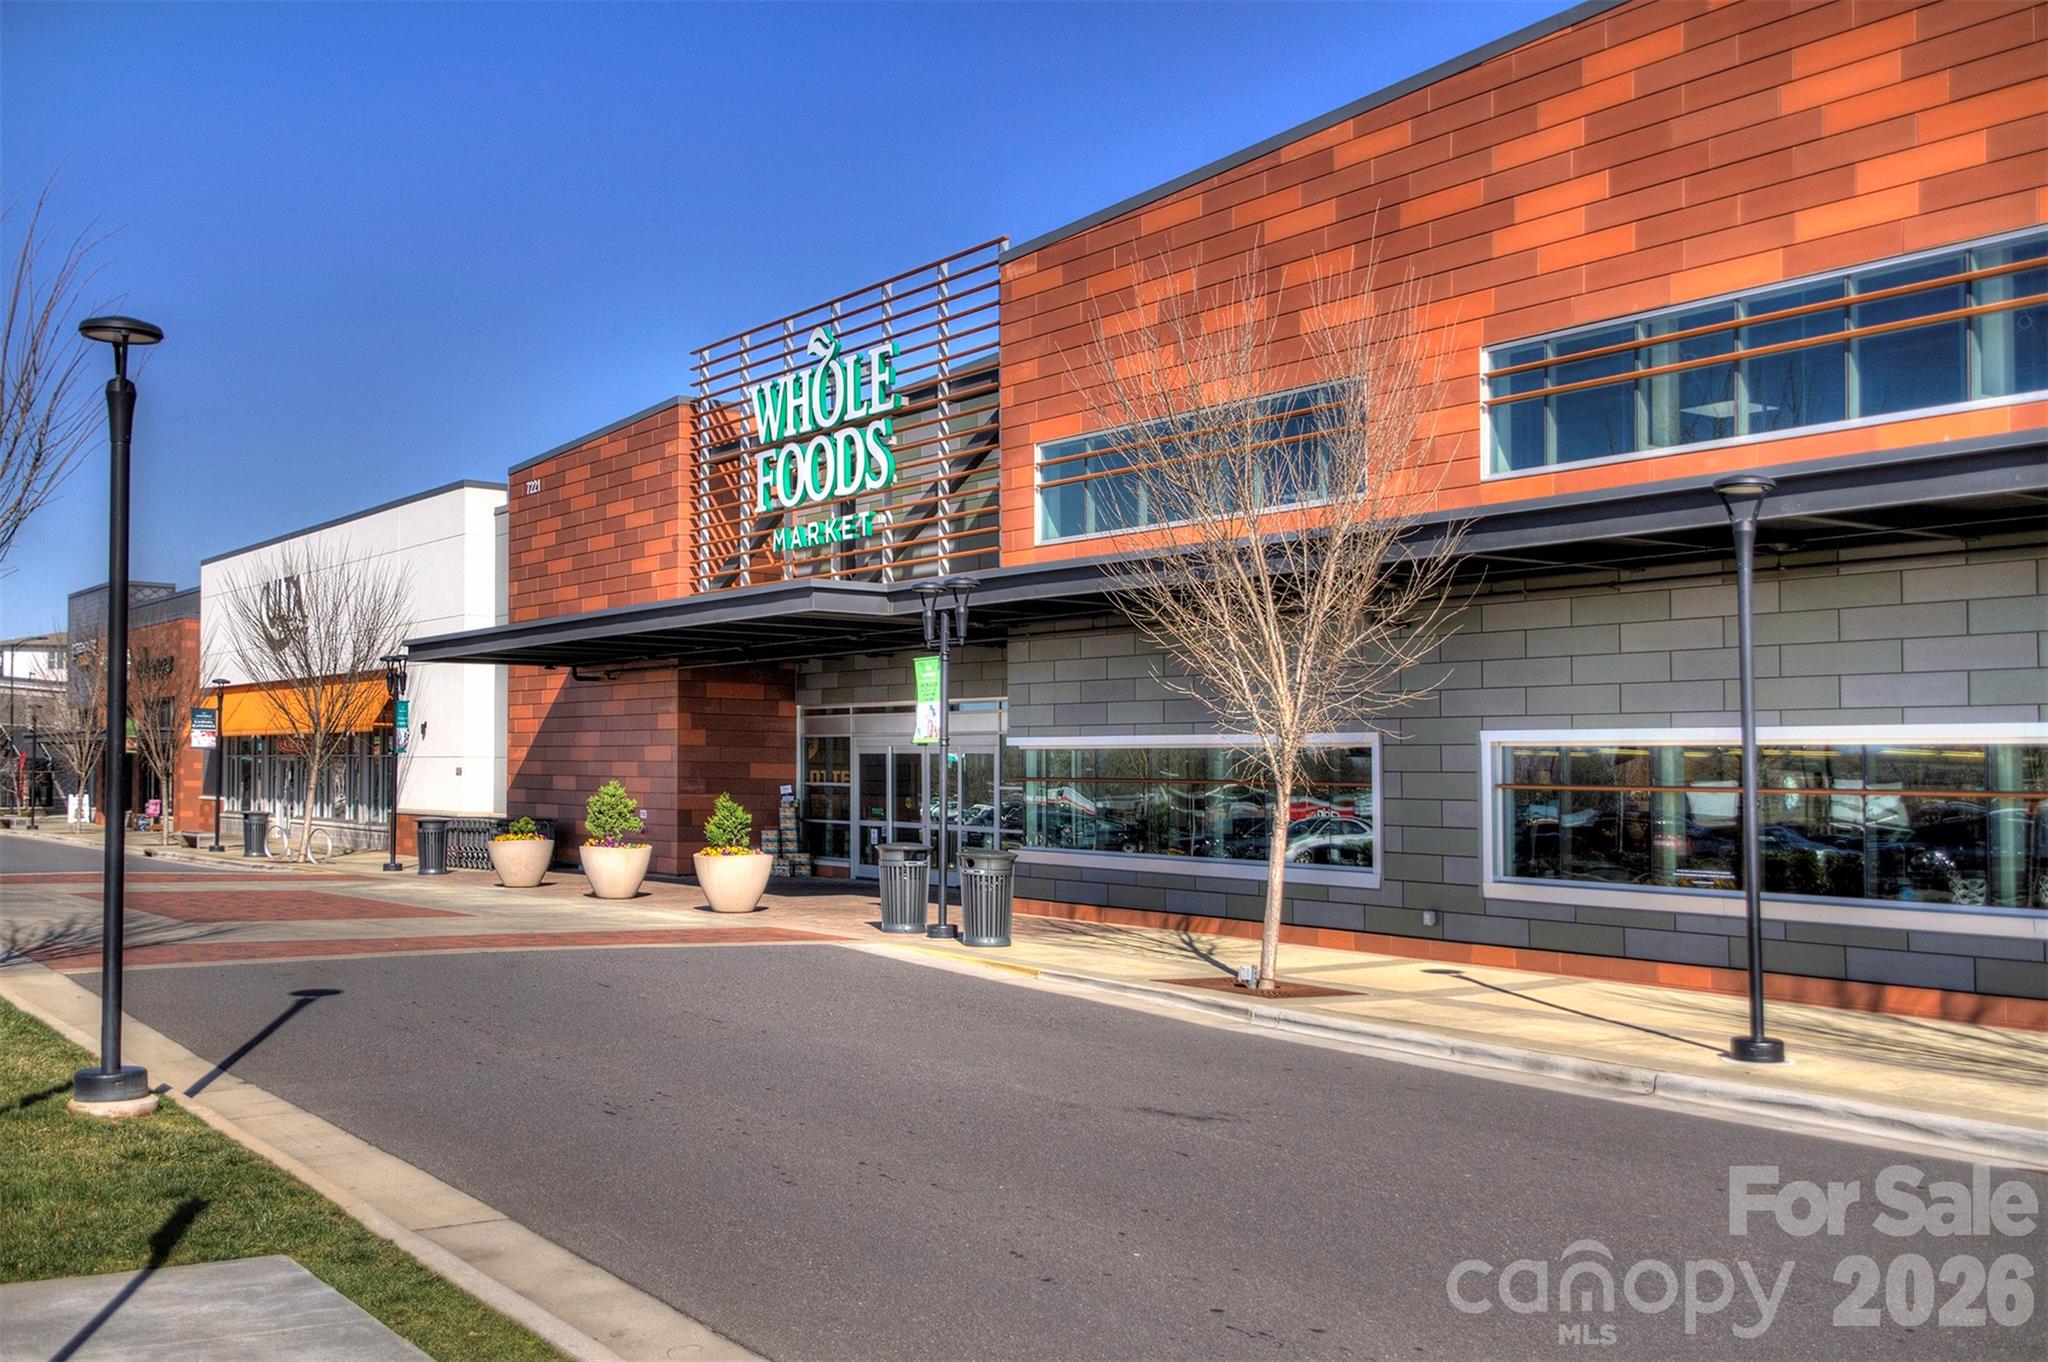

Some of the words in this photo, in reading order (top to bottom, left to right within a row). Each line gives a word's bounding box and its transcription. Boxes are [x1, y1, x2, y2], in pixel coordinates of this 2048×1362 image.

[750, 327, 903, 445] WHOLE
[754, 418, 895, 513] FOODS
[772, 511, 877, 552] MARKET
